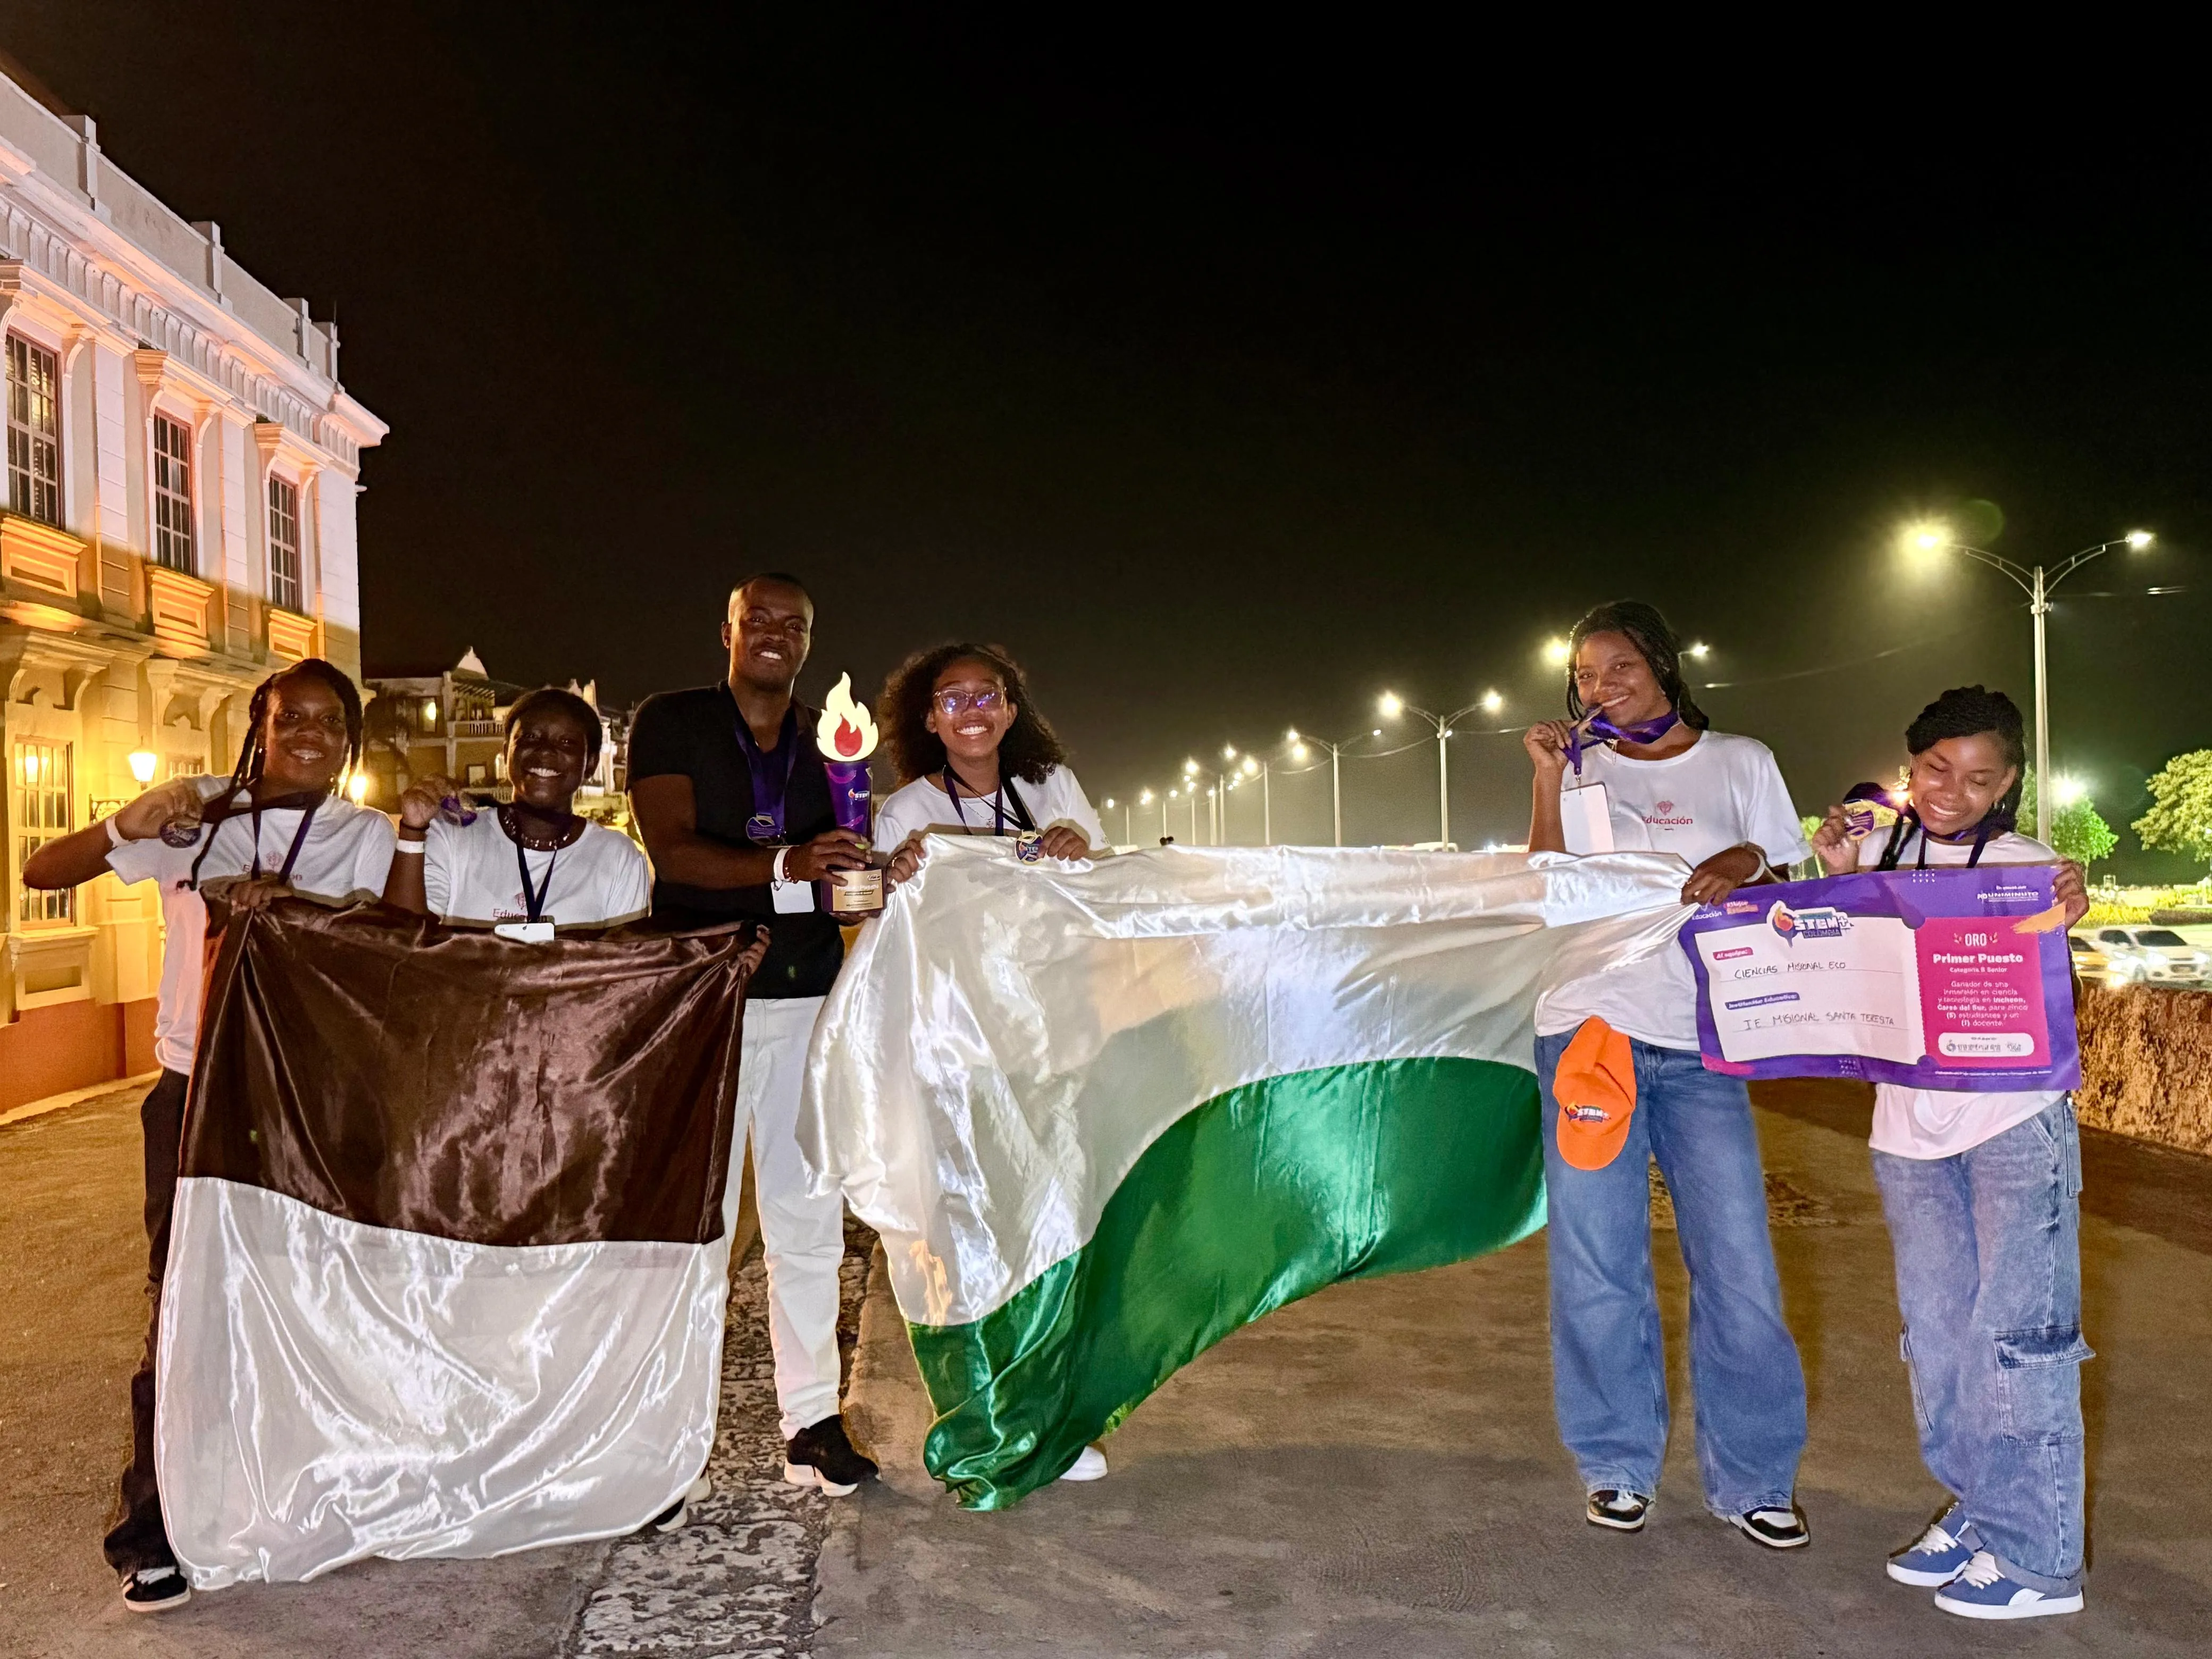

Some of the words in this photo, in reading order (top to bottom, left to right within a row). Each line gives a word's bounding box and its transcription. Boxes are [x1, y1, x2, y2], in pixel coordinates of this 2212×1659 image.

[1642, 815, 1693, 824] Educación
[493, 908, 548, 922] Educn
[1794, 916, 1848, 931] STEM+
[1964, 933, 1987, 946] ORO
[1933, 953, 1975, 963] Primer
[1978, 953, 2023, 963] Puesto
[1735, 965, 1778, 979] CIENCIAS
[1826, 1011, 1856, 1021] SANTA
